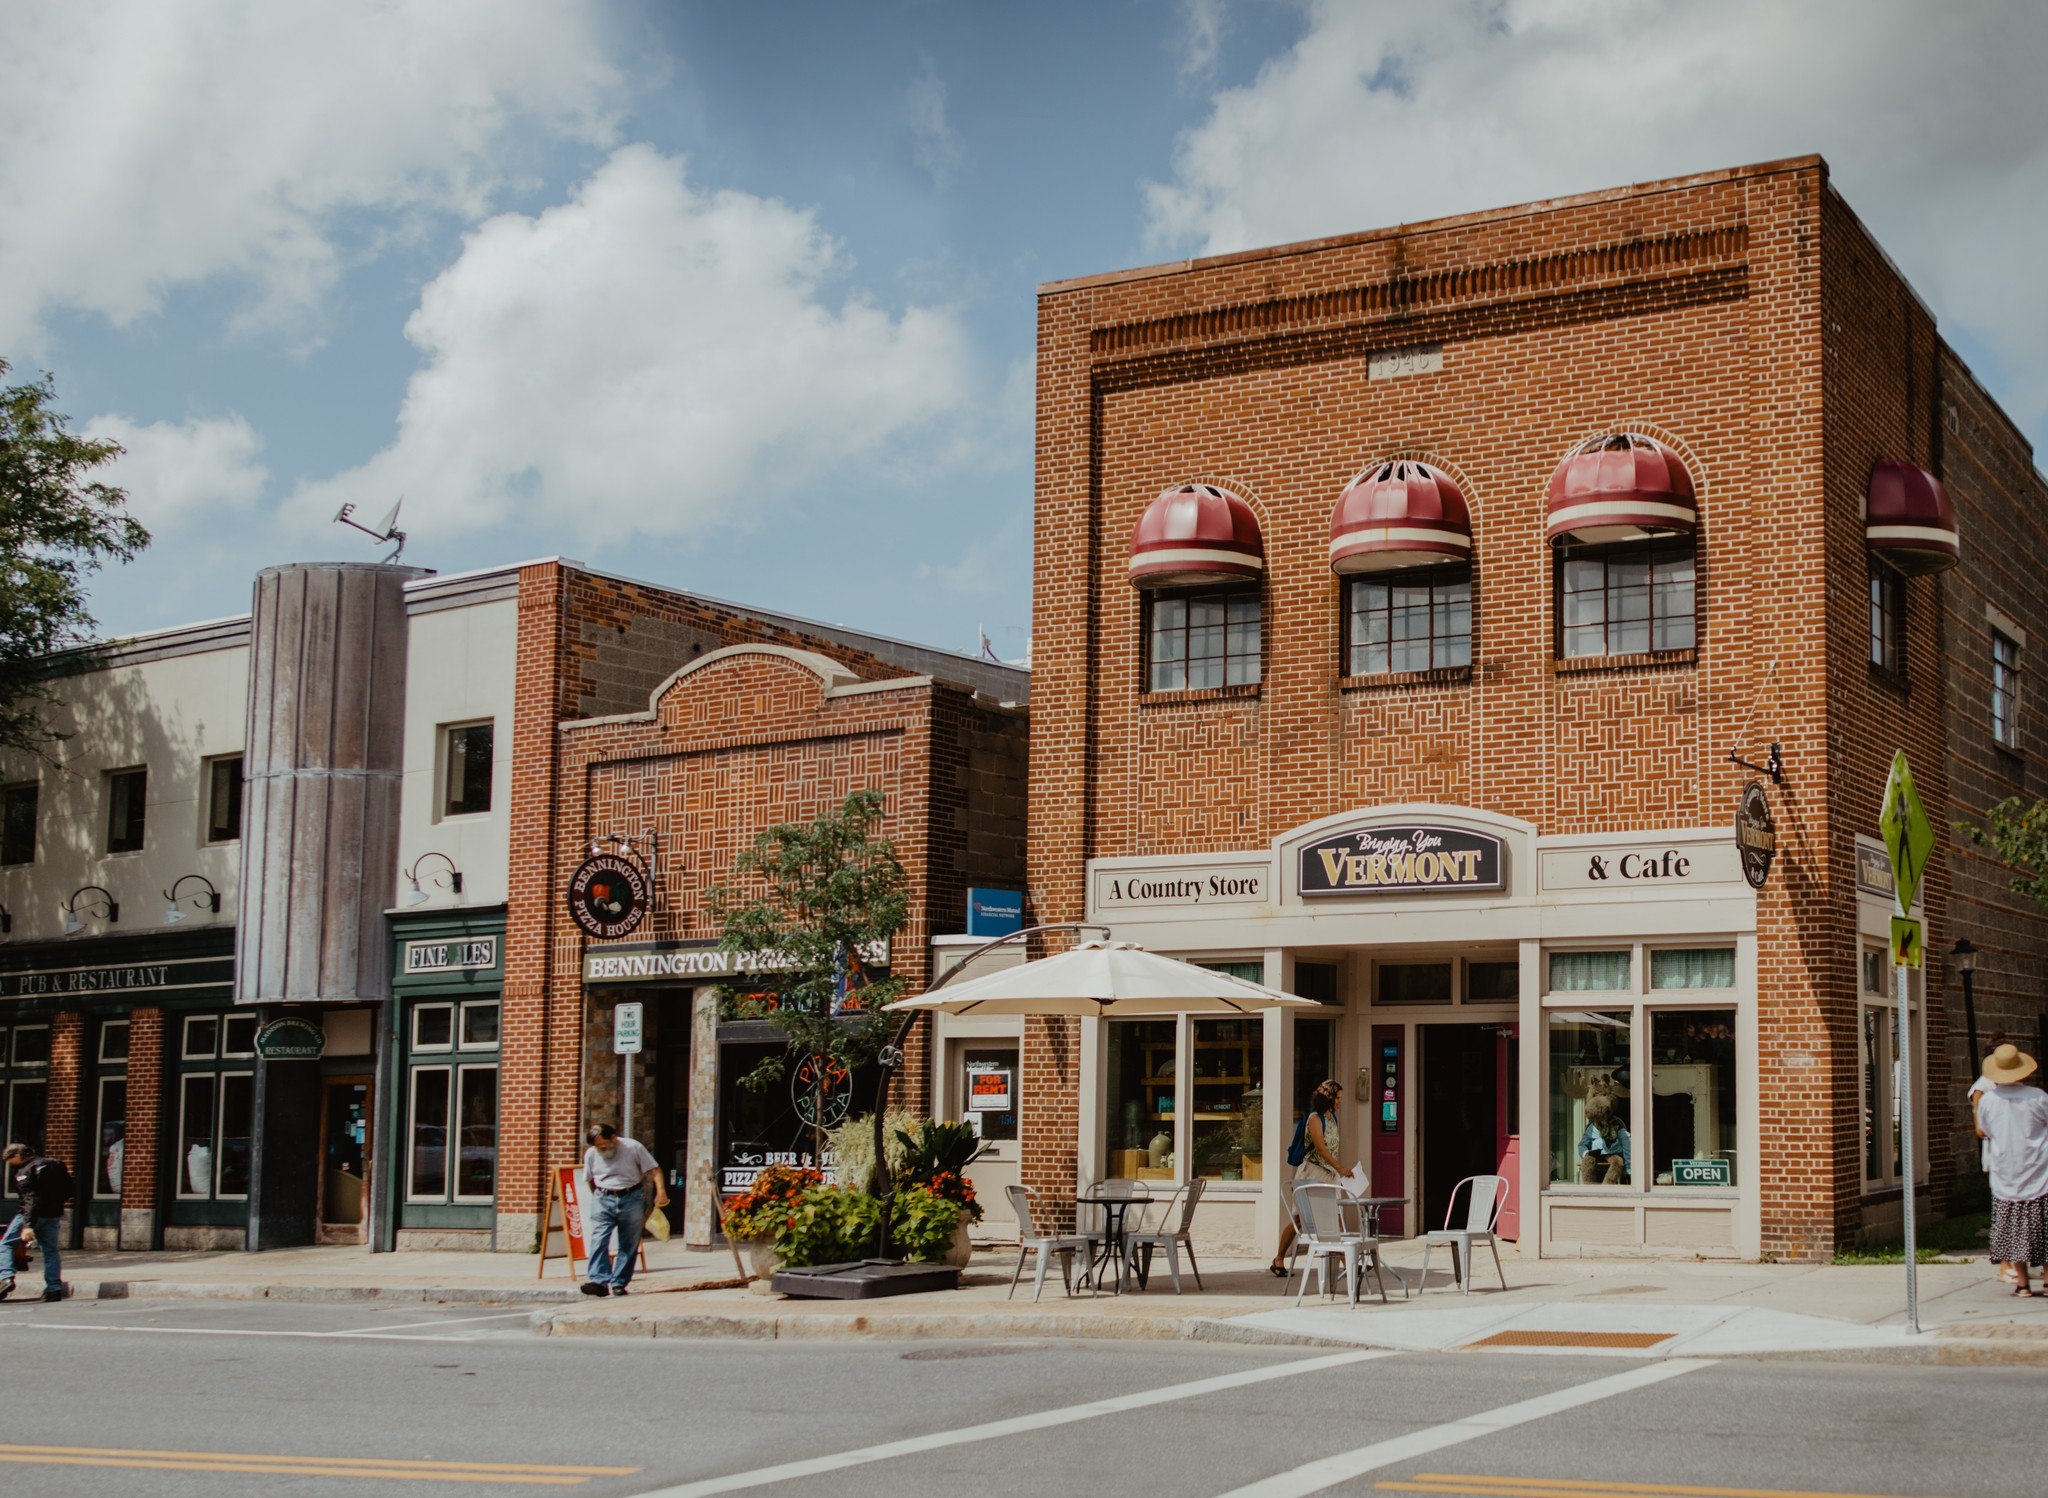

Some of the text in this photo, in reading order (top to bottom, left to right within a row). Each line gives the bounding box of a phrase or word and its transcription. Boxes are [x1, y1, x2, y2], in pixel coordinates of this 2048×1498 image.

[1356, 829, 1442, 868] Bringing You
[1317, 847, 1482, 887] VERMONT
[1588, 849, 1691, 880] & Cafe
[574, 858, 645, 900] BENNINGTON
[1109, 874, 1259, 903] A Country Store
[574, 899, 643, 936] PIZZA HOUSE
[410, 944, 448, 968] FINE
[588, 951, 730, 978] BENNINGTON
[19, 975, 47, 994] PUB
[52, 974, 62, 992] &
[68, 966, 168, 991] RESTAURANT
[616, 1029, 640, 1038] PARKING
[621, 1020, 636, 1028] HOUR
[265, 1045, 319, 1055] RESTAURANT
[973, 1084, 1007, 1095] RENT
[979, 1075, 1002, 1084] FOR
[765, 1151, 798, 1166] BEER
[1682, 1167, 1721, 1180] OPEN
